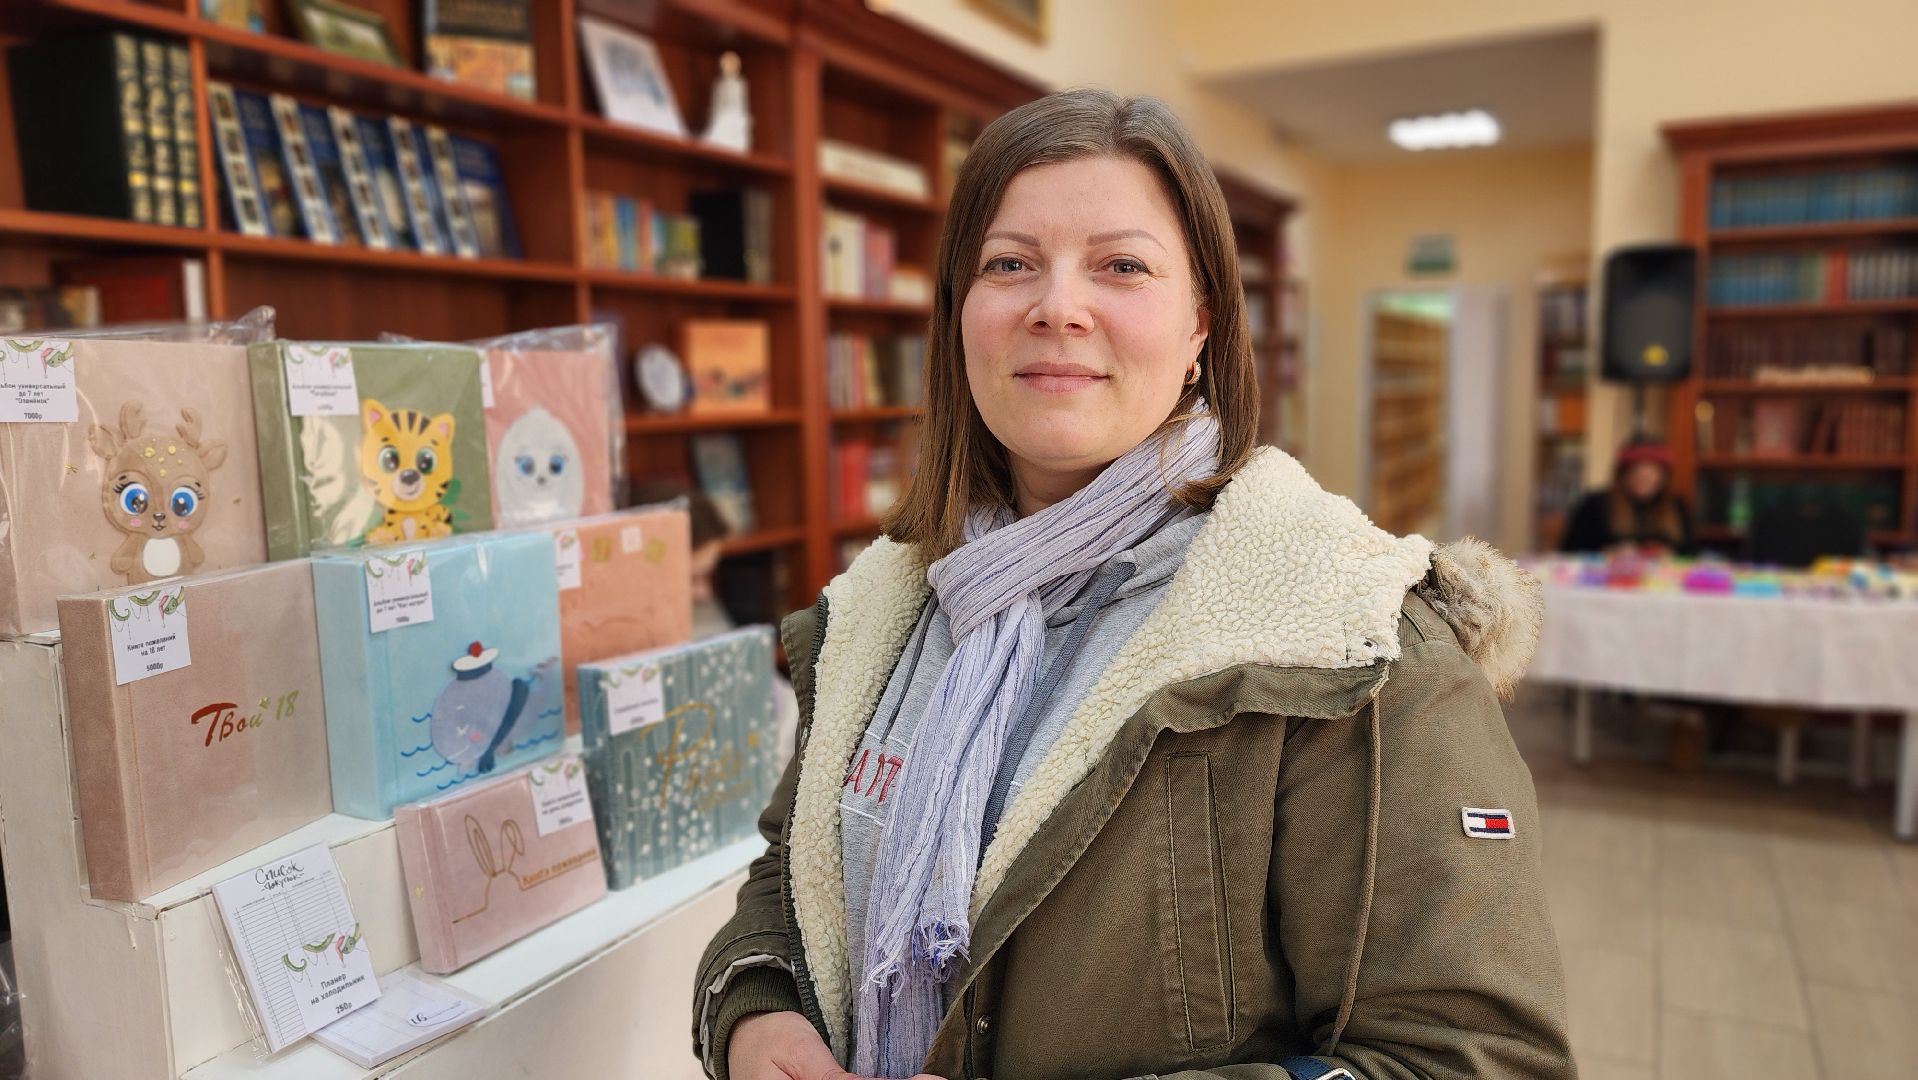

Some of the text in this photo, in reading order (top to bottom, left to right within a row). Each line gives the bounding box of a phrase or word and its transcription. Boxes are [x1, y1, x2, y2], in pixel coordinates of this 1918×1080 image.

[23, 412, 43, 420] 7000р
[126, 633, 176, 652] Книга пожеланий
[149, 646, 156, 654] 18
[156, 645, 166, 653] лет
[146, 663, 163, 672] 5000р
[276, 690, 299, 720] 18
[256, 859, 305, 884] Список
[320, 973, 347, 989] Планер
[310, 975, 366, 1005] на холодильник
[335, 1002, 353, 1014] 250р
